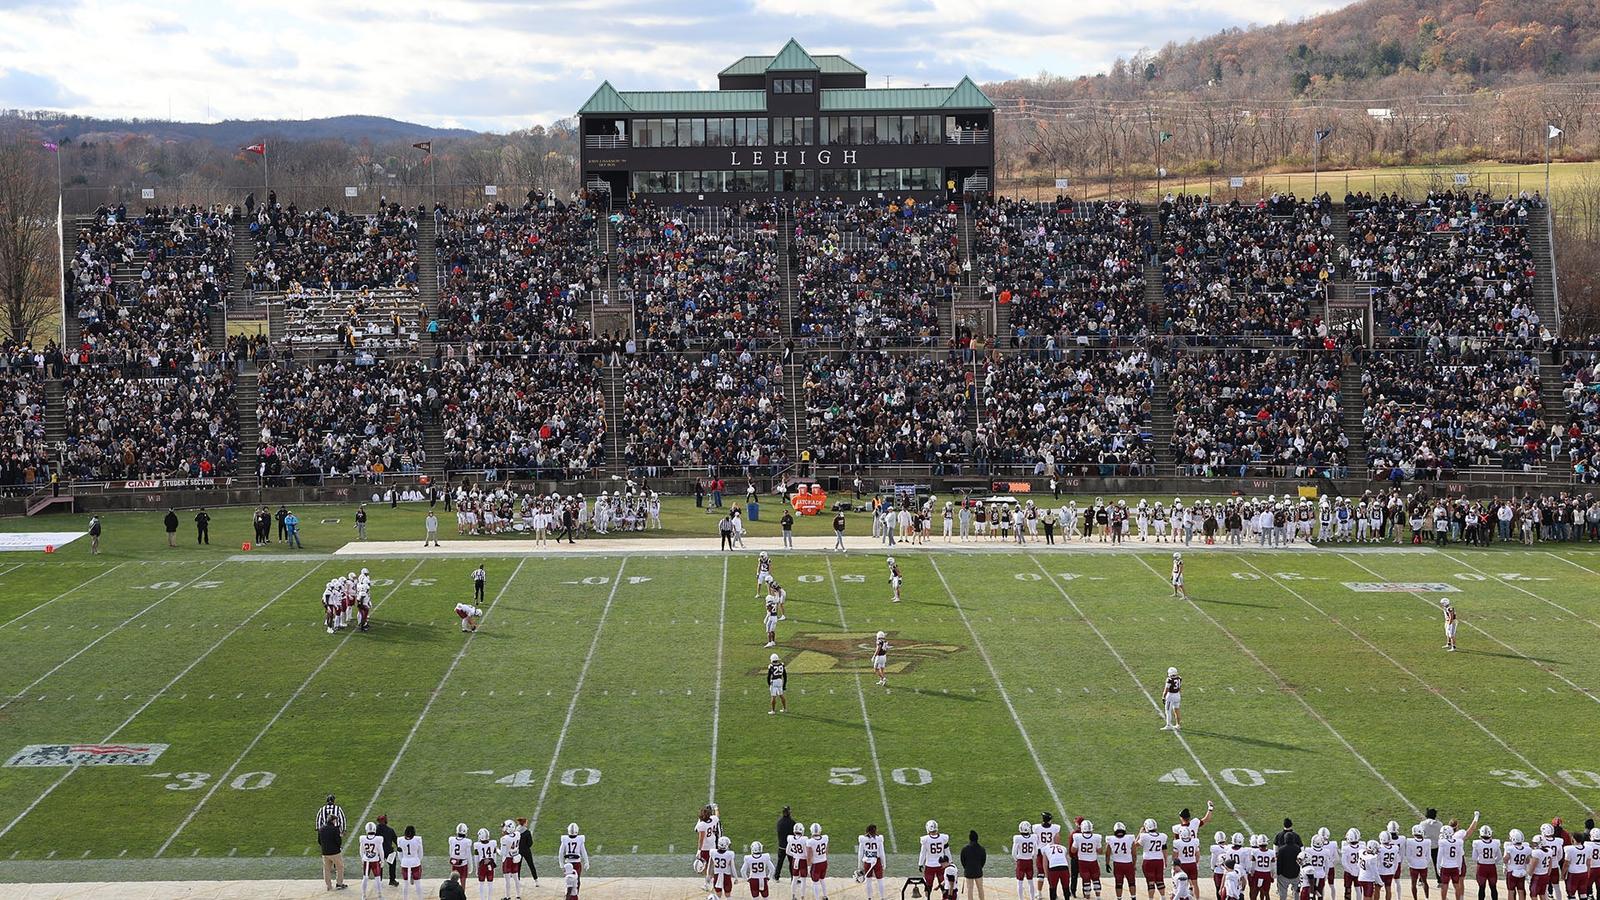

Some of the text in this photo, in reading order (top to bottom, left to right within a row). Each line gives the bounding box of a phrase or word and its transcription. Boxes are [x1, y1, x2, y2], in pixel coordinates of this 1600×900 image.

[731, 150, 857, 165] LEHIGH
[162, 479, 188, 487] STUDENT
[190, 478, 214, 486] SECTION
[337, 488, 349, 496] WC
[774, 666, 784, 676] 29
[828, 767, 933, 786] 50
[1041, 832, 1053, 843] 63
[364, 843, 376, 853] 27
[406, 844, 412, 855] 1
[454, 844, 461, 855] 2
[567, 842, 577, 853] 17
[791, 843, 803, 853] 38
[815, 843, 827, 855] 42
[930, 842, 943, 854] 65
[1021, 842, 1034, 853] 86
[1080, 843, 1093, 853] 62
[1114, 842, 1127, 854] 74
[1148, 840, 1161, 852] 72
[1182, 845, 1194, 857] 49
[1416, 846, 1423, 857] 3
[1449, 846, 1456, 857] 6
[482, 847, 492, 858] 14
[1383, 852, 1395, 863] 26
[1482, 848, 1493, 859] 81
[1592, 849, 1600, 860] 8
[714, 857, 727, 868] 33
[1257, 856, 1270, 867] 29
[1311, 855, 1325, 867] 23
[1513, 854, 1526, 865] 48
[1575, 853, 1586, 865] 71
[751, 862, 765, 873] 59
